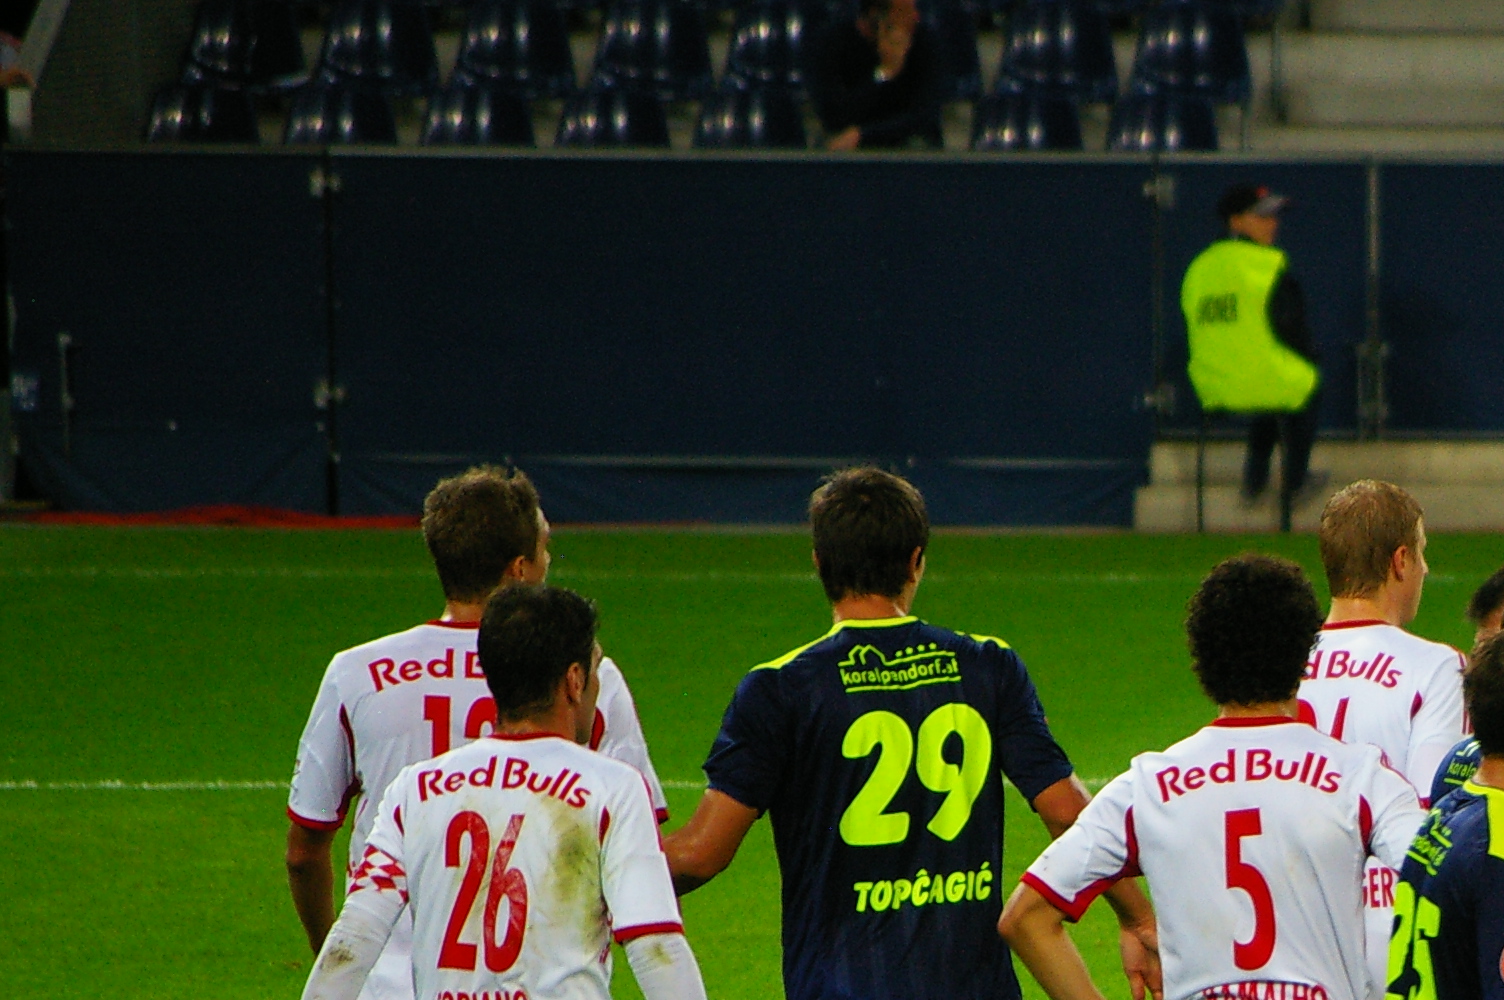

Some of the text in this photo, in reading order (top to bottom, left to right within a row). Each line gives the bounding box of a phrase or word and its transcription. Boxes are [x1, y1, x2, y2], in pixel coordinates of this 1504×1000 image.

[368, 648, 454, 692] Red
[1326, 649, 1403, 688] Bulls
[418, 756, 591, 808] Red Bulls
[839, 703, 992, 846] 29
[1156, 749, 1342, 803] Red Bulls
[437, 810, 528, 973] 26
[1225, 807, 1276, 971] 5
